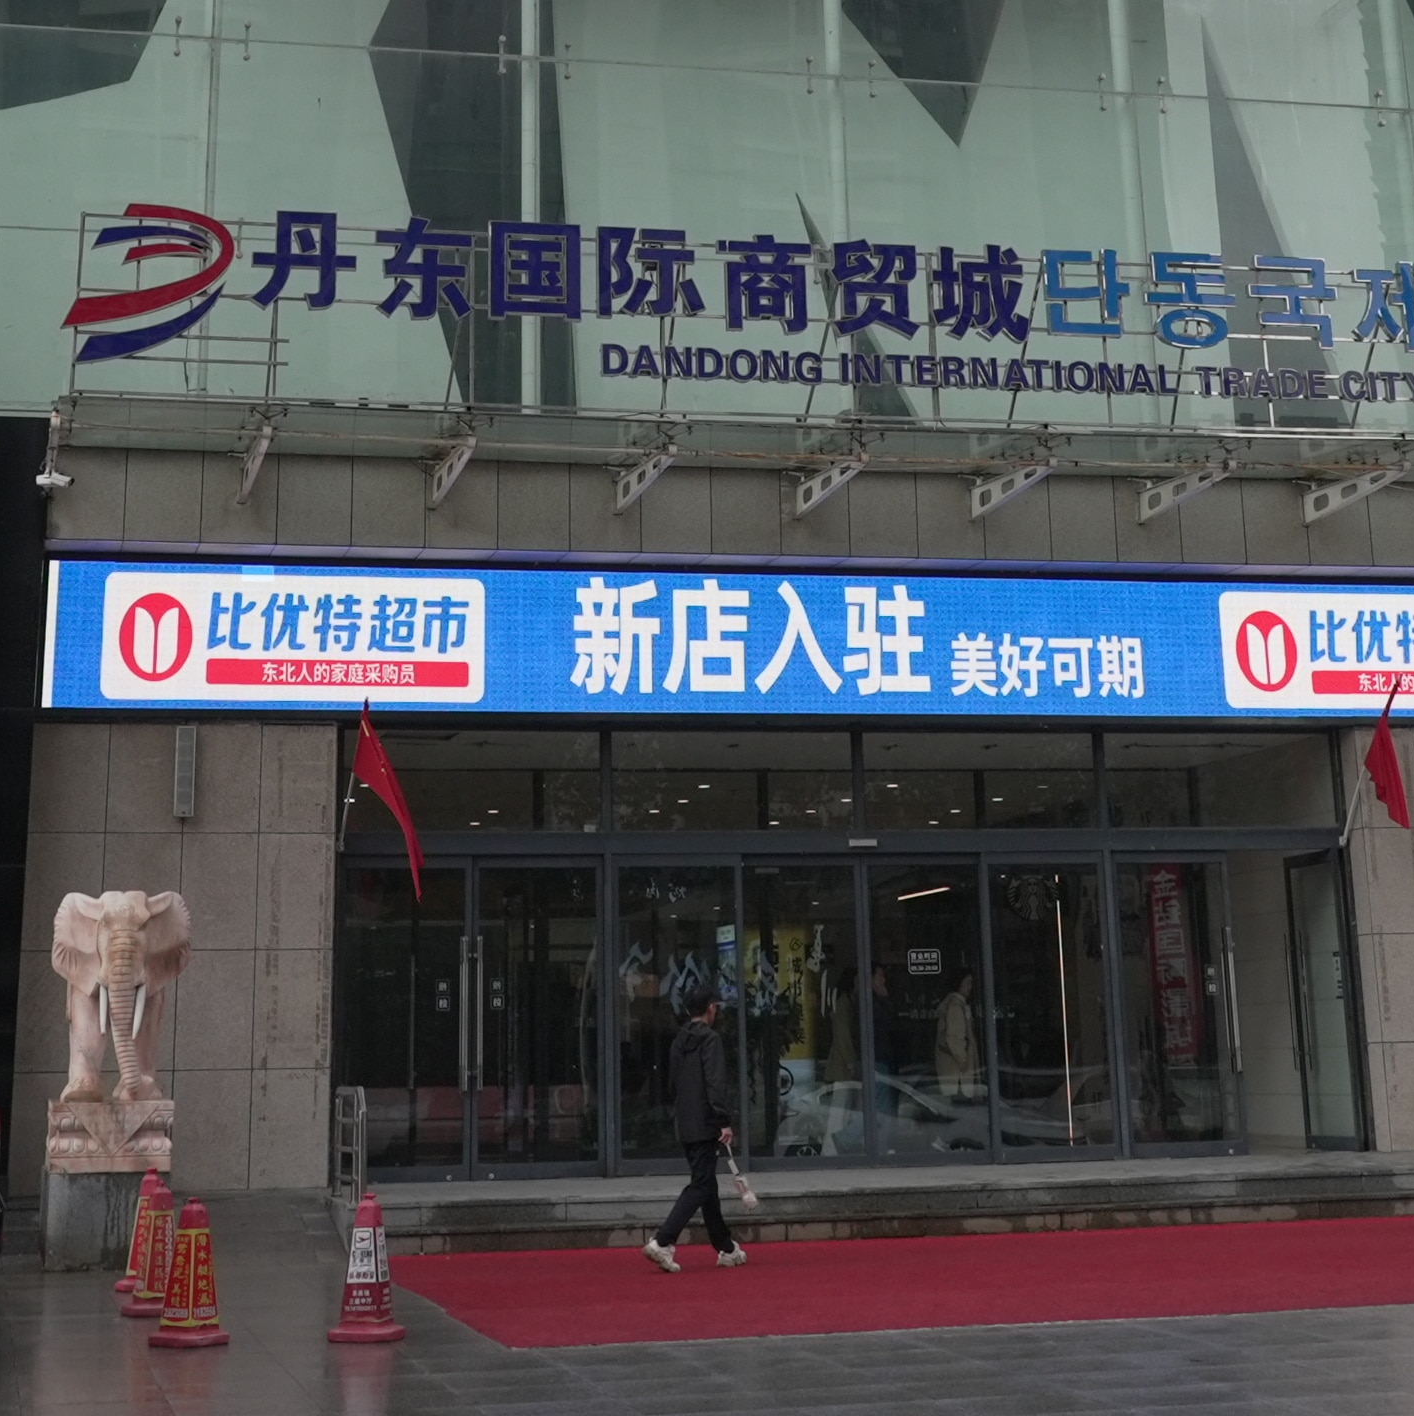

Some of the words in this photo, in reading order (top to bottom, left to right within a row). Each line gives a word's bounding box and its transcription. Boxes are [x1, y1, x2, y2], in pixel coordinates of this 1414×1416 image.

[251, 210, 1028, 342] 丹东国际商贸城
[601, 342, 824, 385] DANDONG
[839, 344, 1178, 398] INTERNATIONAL
[1198, 365, 1331, 402] TRADE
[206, 592, 470, 654] 比优特超市
[569, 576, 931, 697] 新店入驻
[949, 631, 1145, 700] 美好可期
[261, 662, 416, 685] 东北人的家庭采购员
